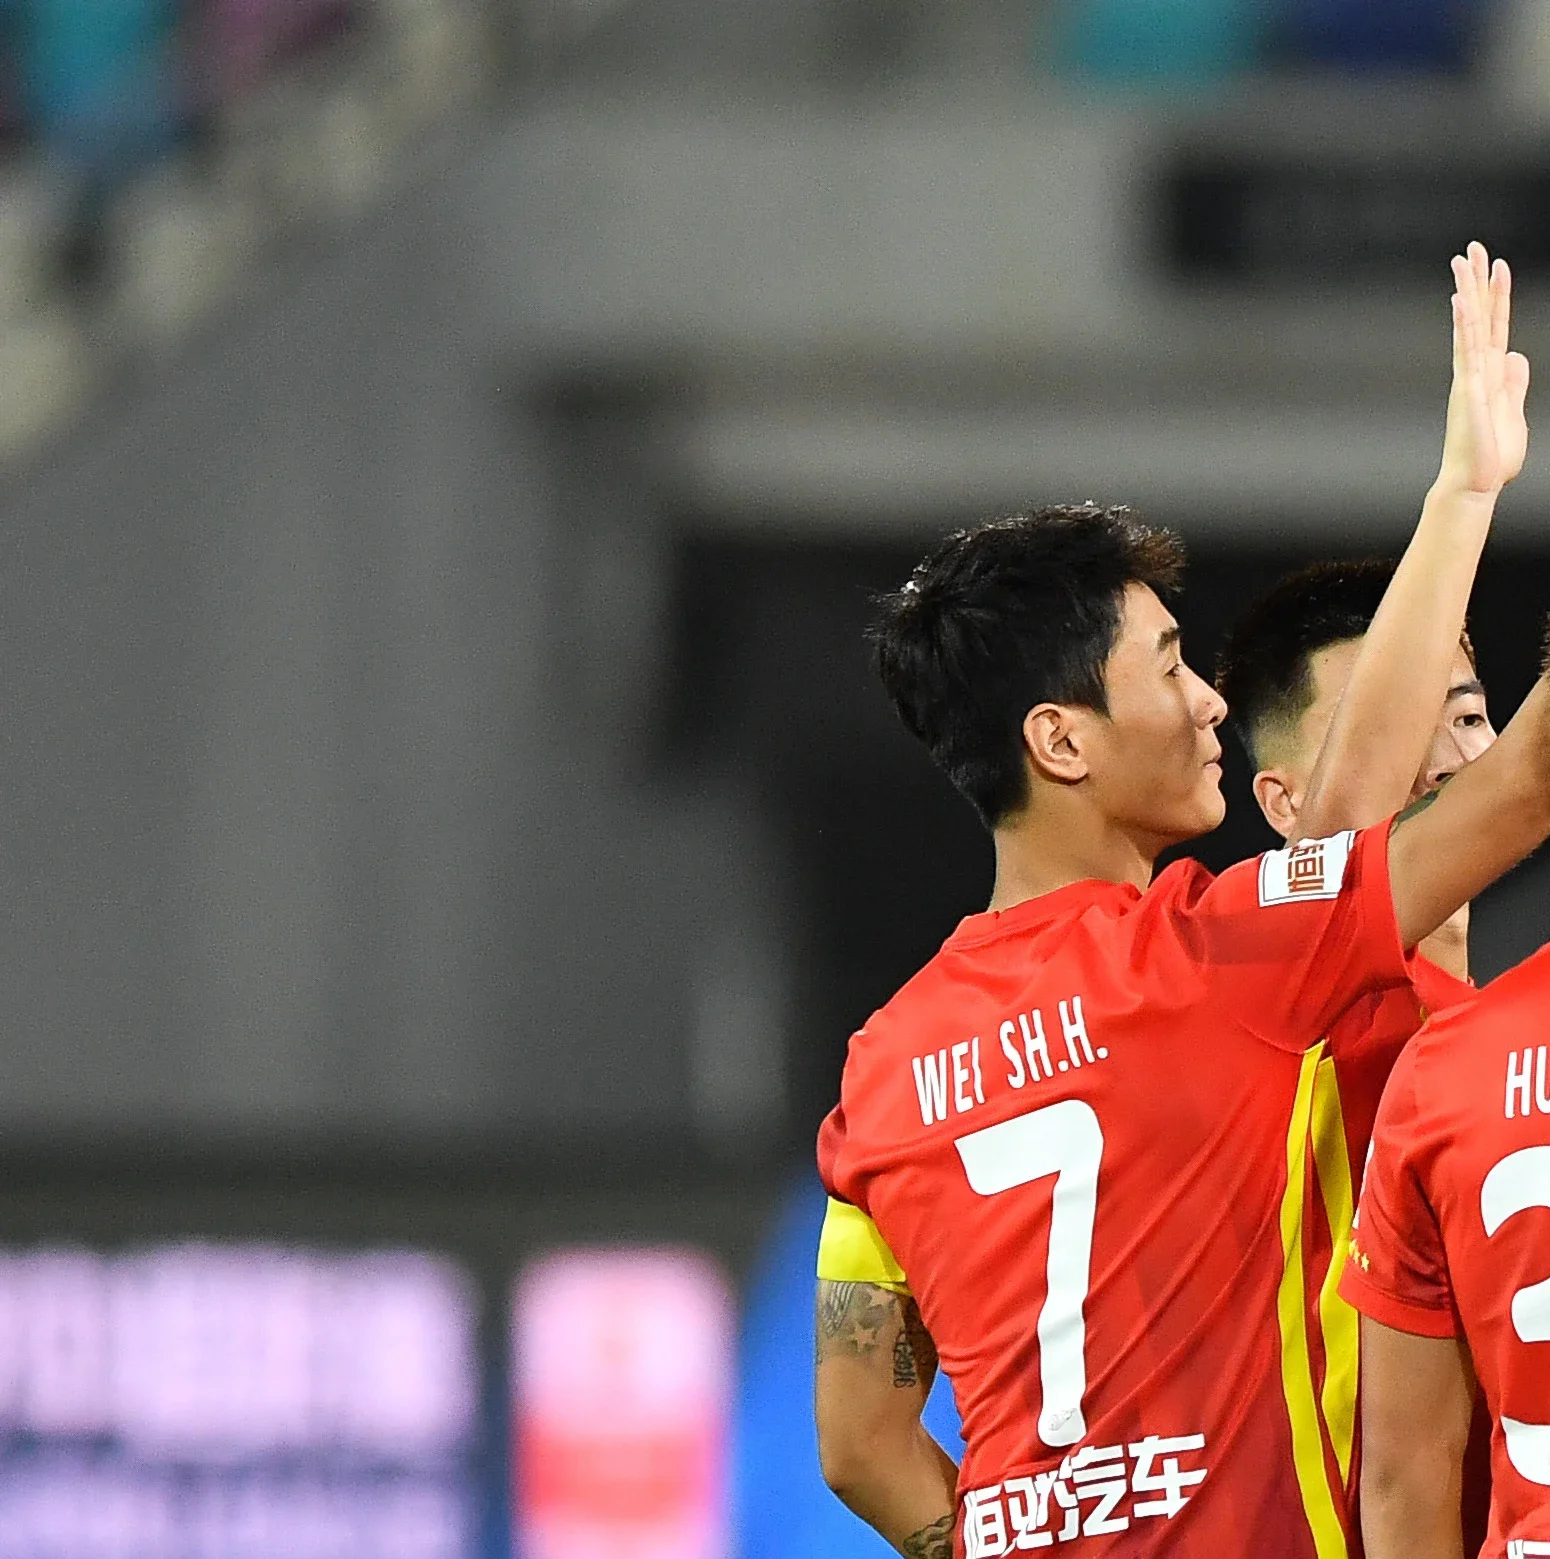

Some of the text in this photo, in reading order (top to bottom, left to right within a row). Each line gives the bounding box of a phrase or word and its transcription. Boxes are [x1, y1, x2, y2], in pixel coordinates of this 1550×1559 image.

[911, 996, 1110, 1126] WEI SH.H.
[953, 1098, 1105, 1449] 7
